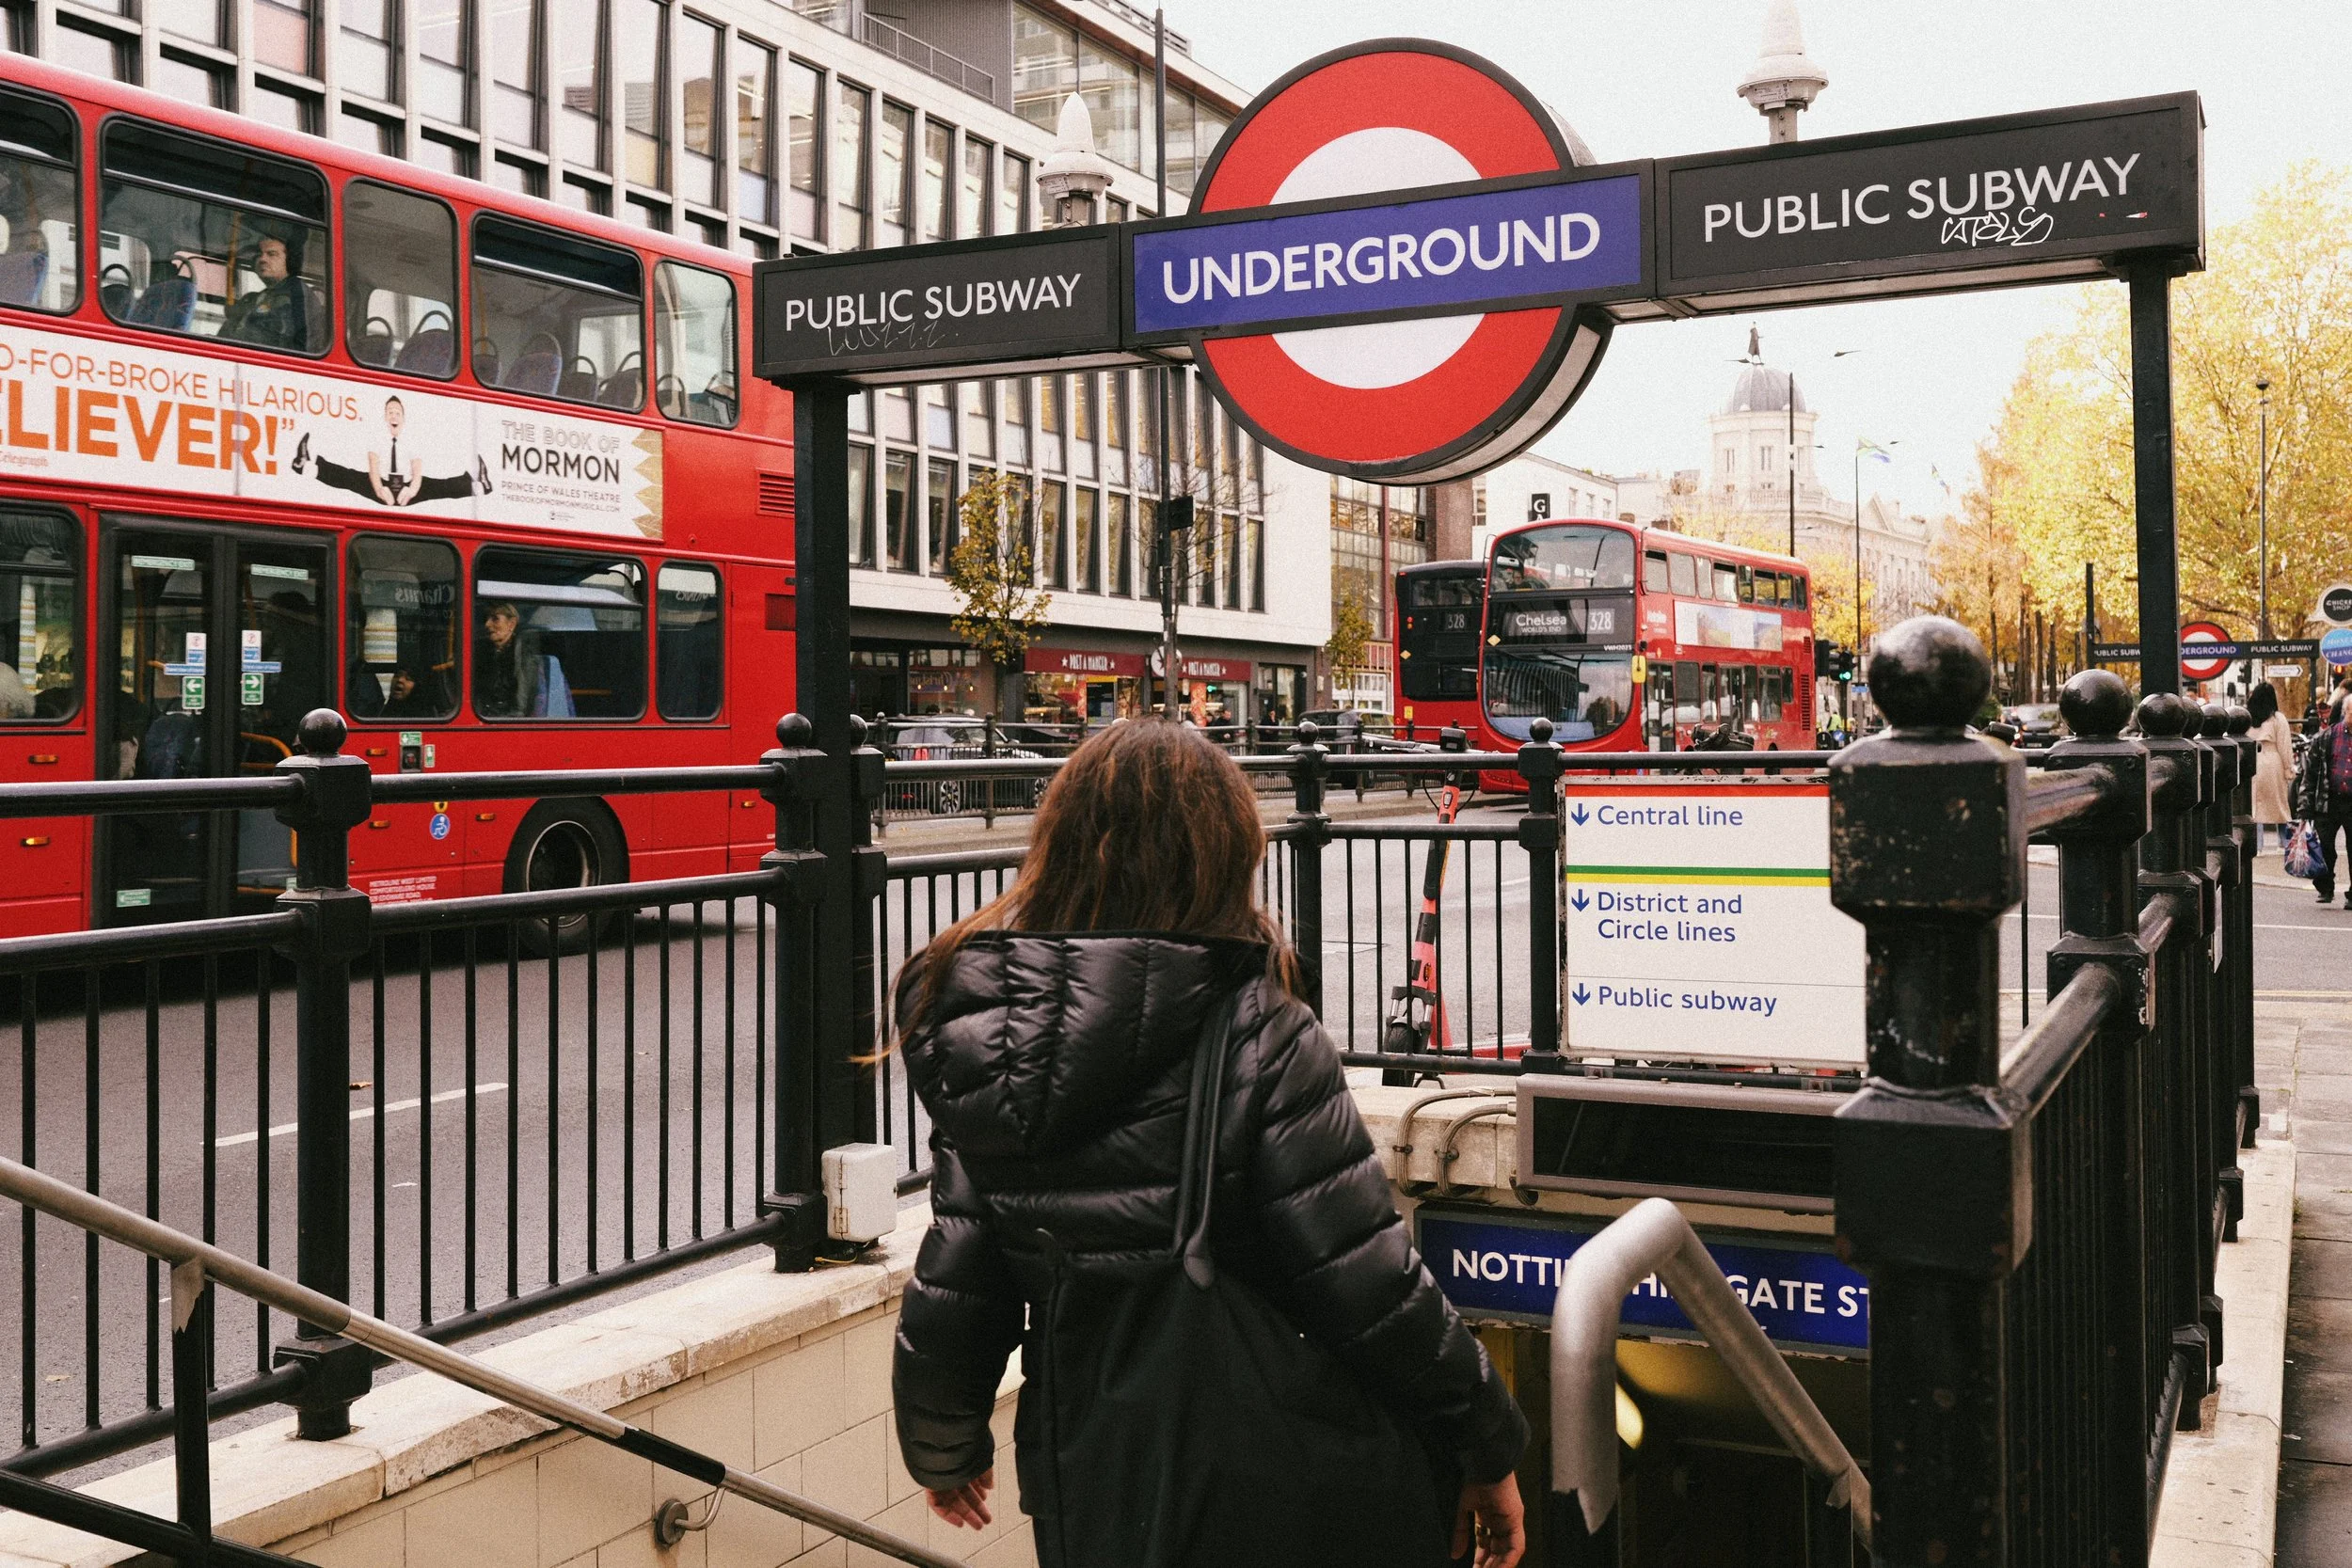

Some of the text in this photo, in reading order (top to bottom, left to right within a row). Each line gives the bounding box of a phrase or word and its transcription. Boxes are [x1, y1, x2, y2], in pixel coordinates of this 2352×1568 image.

[1704, 152, 2141, 243] PUBLIC SUBWAY
[1163, 213, 1601, 305] UNDERGROUND
[786, 273, 1082, 331] PUBLIC SUBWAY
[219, 377, 363, 422] HILARIOUS.
[0, 377, 294, 476] LIEVER!”
[501, 420, 620, 454] THE BOOK OF
[501, 443, 620, 484] MORMON
[501, 481, 621, 503] PRINCE OF WALES THEATRE
[1447, 613, 1465, 629] 328
[1516, 611, 1612, 631] Chelsea 328
[1547, 625, 1563, 634] END
[2120, 648, 2141, 657] SUBW
[2181, 645, 2237, 656] DERGROUND
[2250, 644, 2313, 654] PUBLIC SUBWAY
[1069, 653, 1083, 671] PRET
[1597, 804, 1743, 826] Central line
[1597, 891, 1743, 913] District and
[1597, 918, 1737, 942] Circle lines
[1598, 986, 1777, 1017] Public subway
[1452, 1248, 1568, 1290] NOTTI
